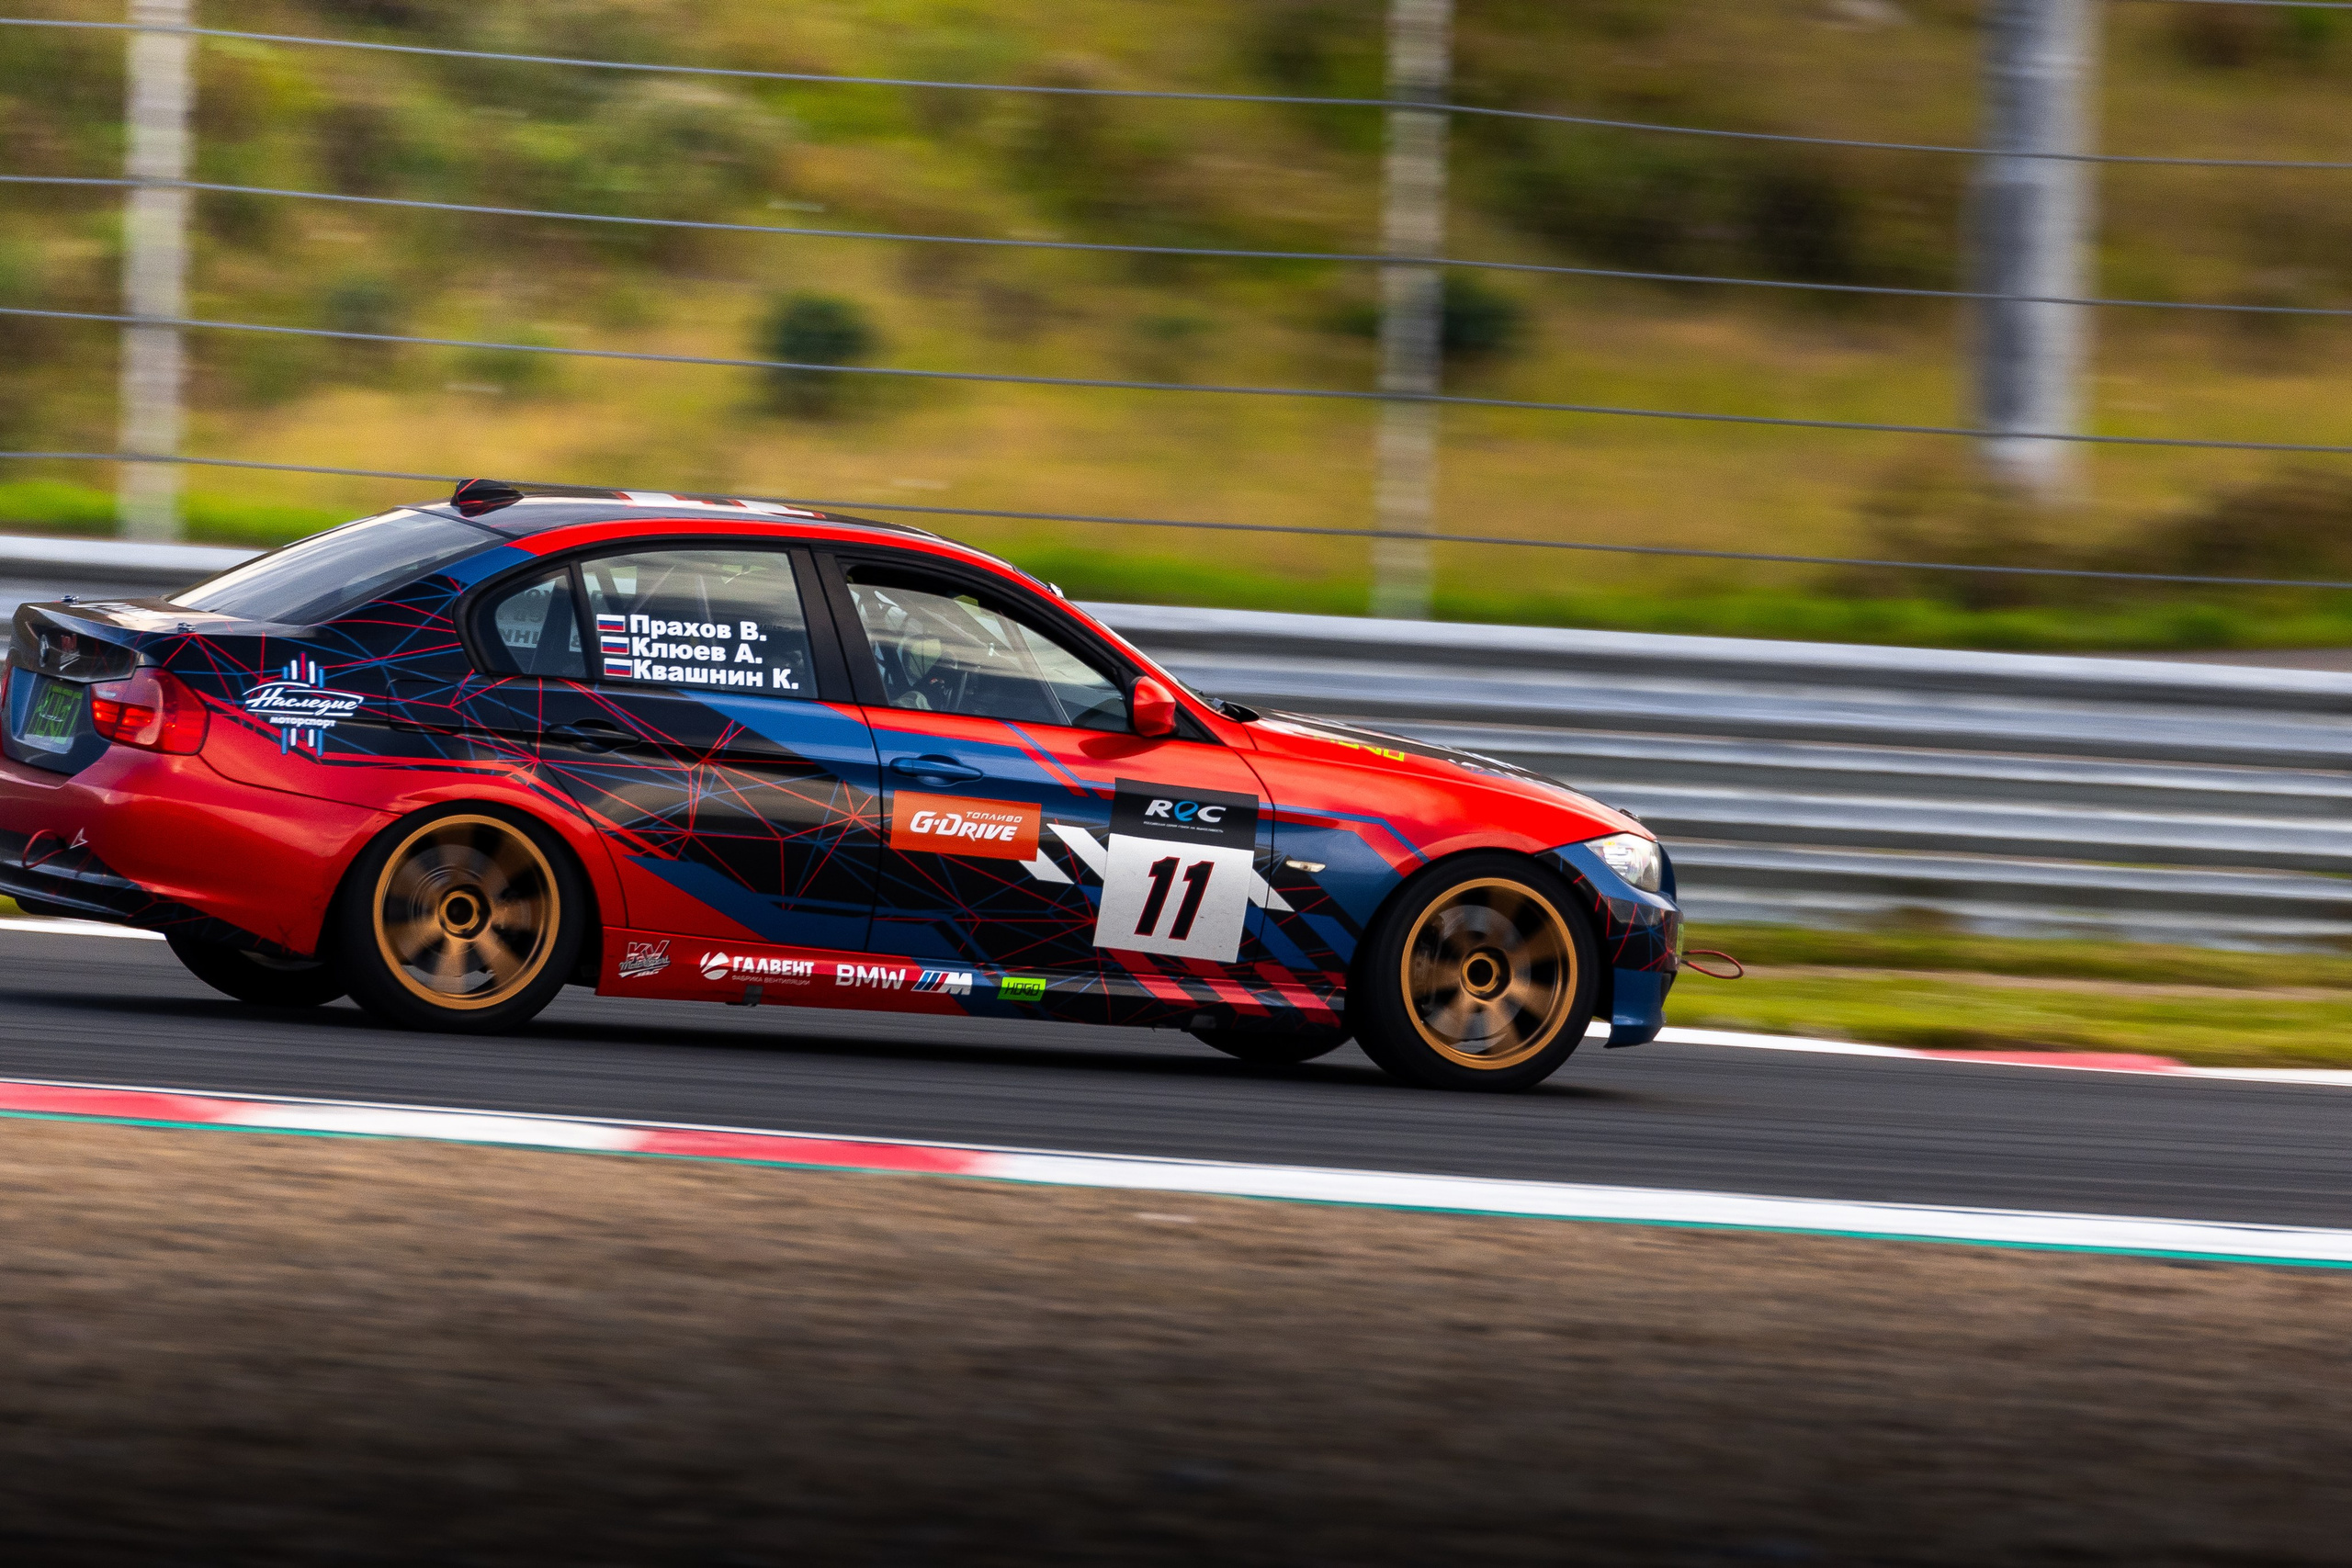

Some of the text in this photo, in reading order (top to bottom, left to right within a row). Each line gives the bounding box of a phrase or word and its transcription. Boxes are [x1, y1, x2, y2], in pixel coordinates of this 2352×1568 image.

[629, 614, 767, 642] Прахов В.
[631, 637, 763, 664] Клюев А.
[633, 659, 799, 690] Квашнин К.
[245, 687, 358, 716] Наследие
[1134, 856, 1215, 941] 11
[732, 956, 815, 977] ГАЛВЕНТ
[835, 964, 906, 990] BMW
